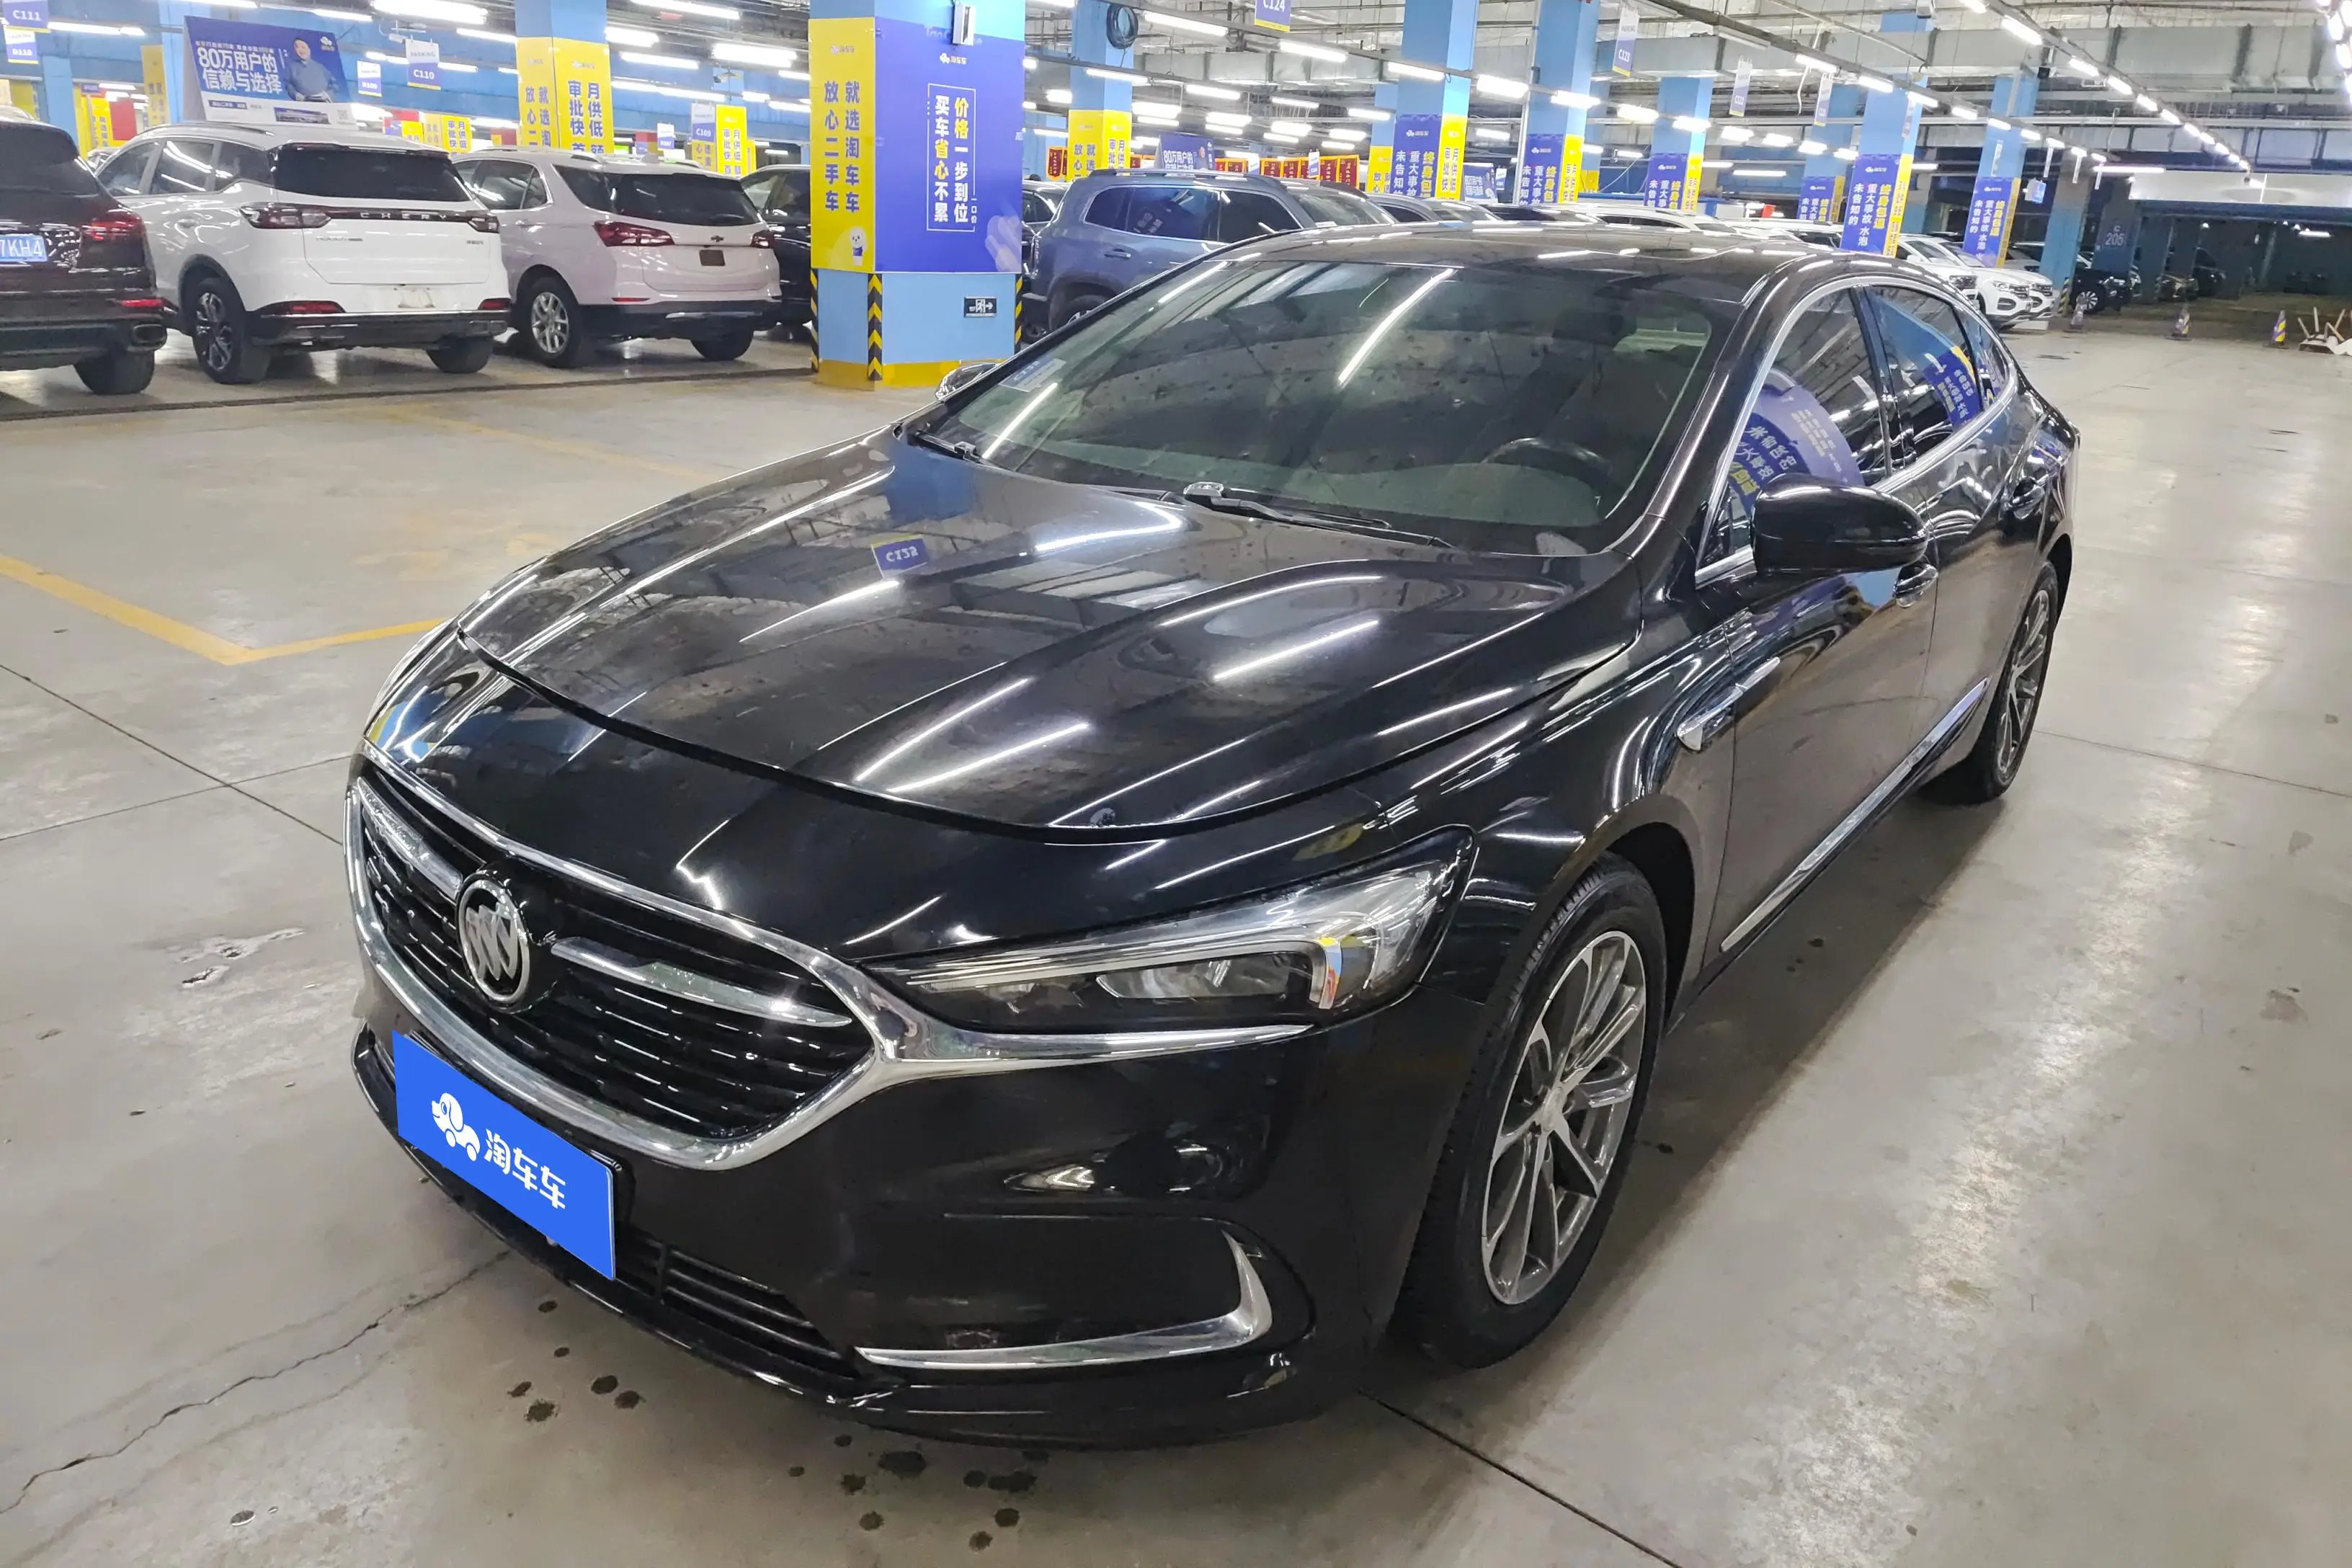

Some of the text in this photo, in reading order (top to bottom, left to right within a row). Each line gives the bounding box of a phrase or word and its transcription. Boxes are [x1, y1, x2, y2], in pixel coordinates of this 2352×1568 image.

[12, 10, 41, 20] C111
[197, 46, 278, 73] 80万用户的
[202, 68, 282, 94] 信赖与选择
[413, 69, 435, 79] C110
[568, 80, 585, 135] 审批快
[588, 82, 603, 137] 月供低
[696, 128, 712, 138] C109
[824, 81, 839, 211] 放心二手车
[845, 81, 860, 213] 就选淘车车
[934, 94, 950, 223] 买车省心不累
[953, 97, 968, 223] 价格一步到位
[360, 212, 447, 220] CHERY
[2105, 233, 2124, 246] 205
